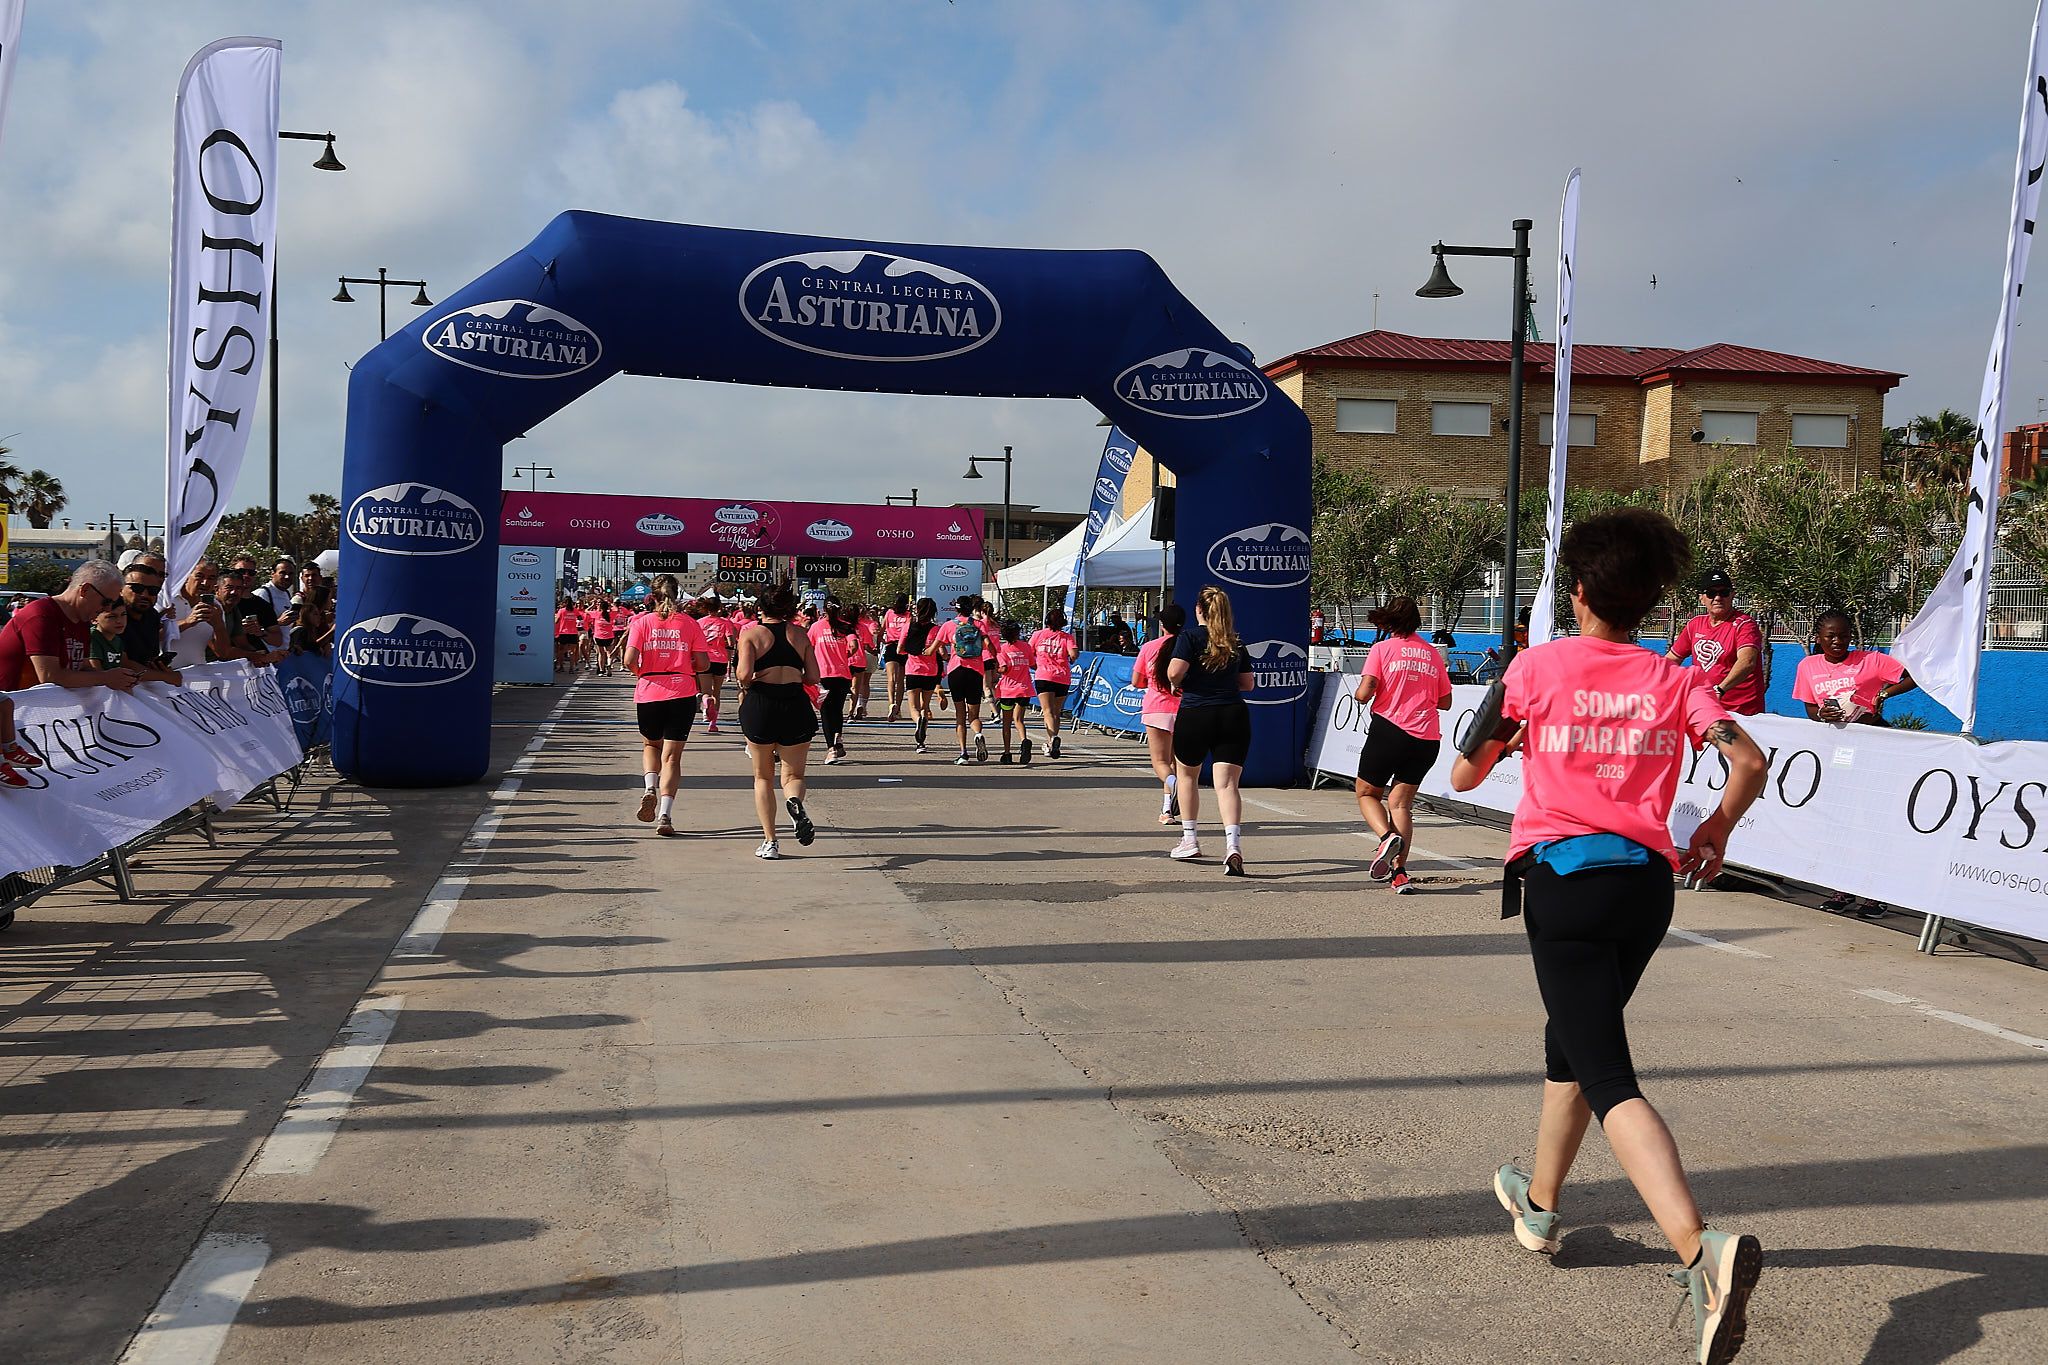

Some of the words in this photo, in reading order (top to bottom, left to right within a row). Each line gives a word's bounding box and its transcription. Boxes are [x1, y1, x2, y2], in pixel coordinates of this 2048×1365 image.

[802, 277, 884, 294] CENTRAL
[892, 285, 974, 301] LECHERA
[759, 276, 981, 337] ASTURIANA
[180, 129, 264, 536] OYSHO
[466, 321, 524, 334] CENTRAL
[530, 328, 588, 343] LECHERA
[433, 321, 588, 365] ASTURIANA
[1152, 372, 1204, 381] CENTRAL
[1209, 371, 1252, 379] LECHERA
[1126, 375, 1261, 400] ASTURIANA
[371, 506, 419, 515] CENTRAL
[425, 508, 473, 520] LECHERA
[718, 510, 756, 519] ASTURIANA
[352, 507, 475, 541] ASTURIANA
[505, 519, 545, 527] Santander
[570, 519, 610, 529] OYSHO
[639, 521, 681, 531] ASTURIANA
[710, 522, 748, 534] Carrera
[809, 526, 850, 537] ASTURIANA
[877, 529, 914, 539] OYSHO
[936, 533, 972, 541] Santander
[731, 533, 760, 551] Mujer
[642, 558, 681, 567] OYSHO
[804, 563, 842, 572] OYSHO
[508, 572, 541, 580] OYSHO
[719, 570, 767, 583] OYSHO
[939, 584, 969, 592] OYSHO
[652, 629, 681, 639] SOMOS
[361, 637, 410, 646] CENTRAL
[415, 639, 463, 649] LECHERA
[644, 640, 689, 652] IMPARABLES
[344, 638, 467, 670] ASTURIANA
[1401, 647, 1432, 661] SOMOS
[1814, 676, 1857, 695] CARRERA
[1573, 689, 1656, 722] SOMOS
[1539, 724, 1678, 757] IMPARABLES
[1595, 763, 1625, 780] 2026
[1907, 768, 2048, 853] OYS
